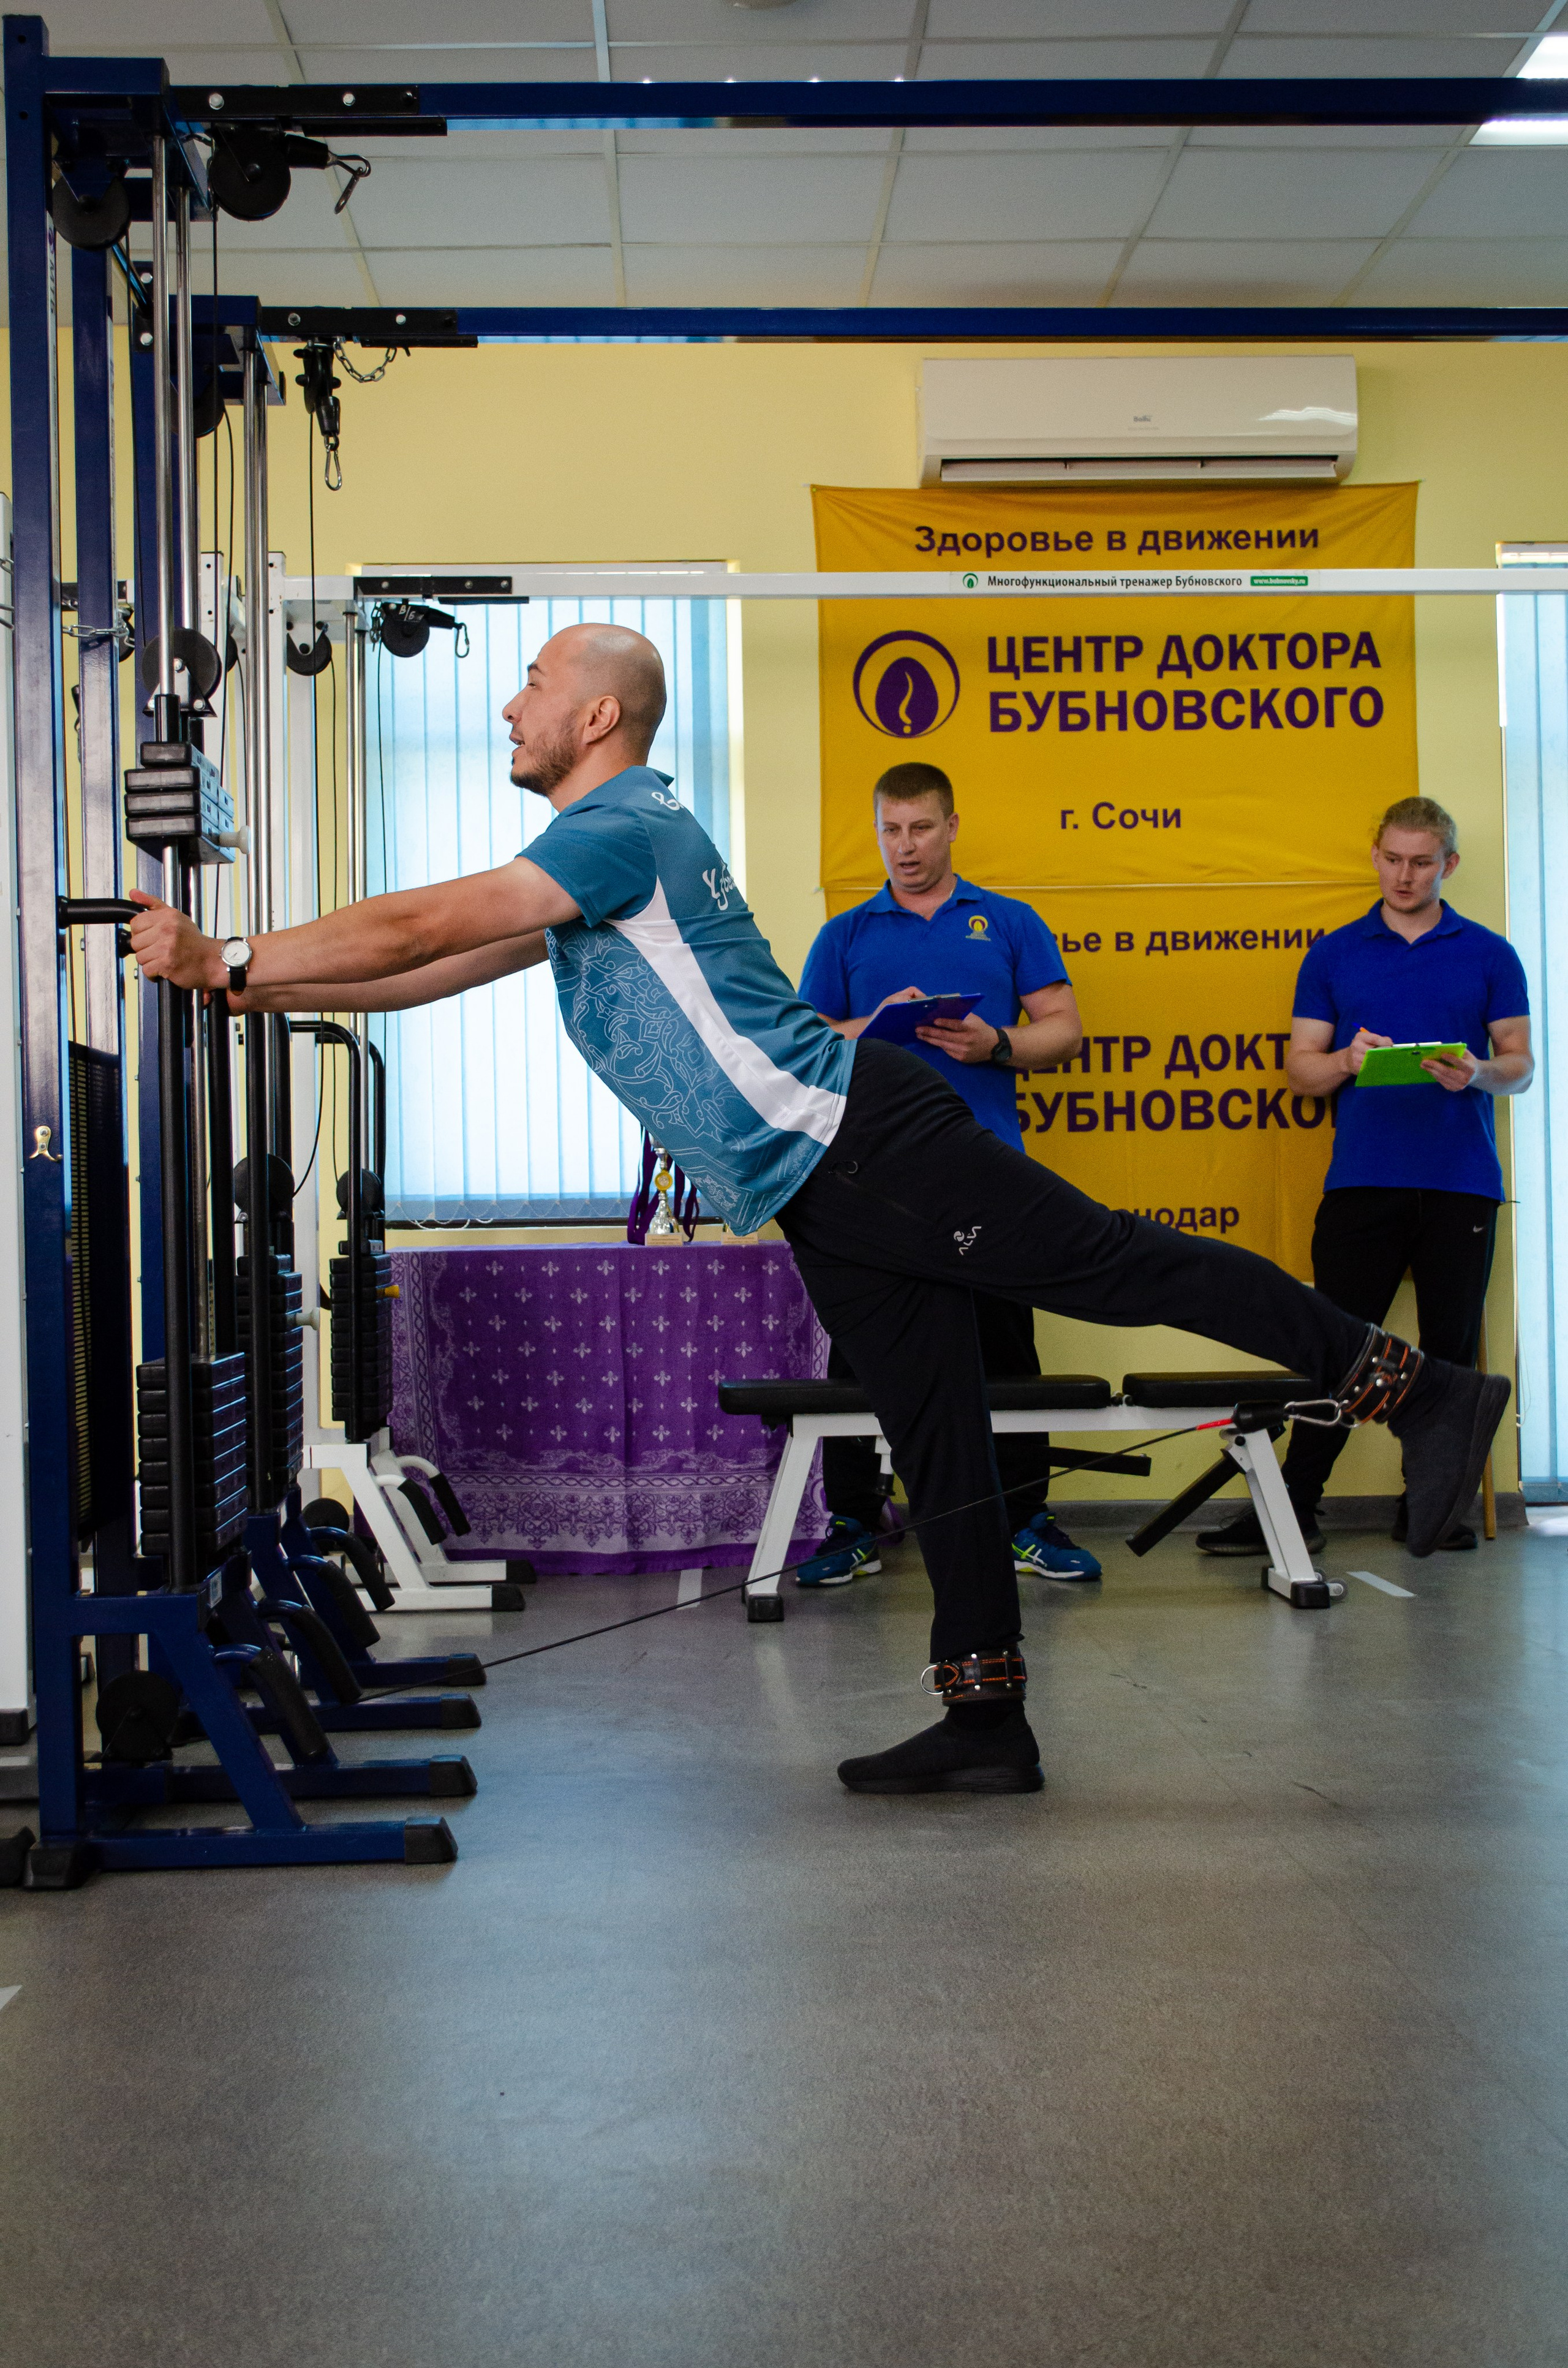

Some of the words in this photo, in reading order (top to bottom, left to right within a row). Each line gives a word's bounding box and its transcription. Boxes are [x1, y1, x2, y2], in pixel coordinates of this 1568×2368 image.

[915, 526, 1093, 558] Здоровье
[1107, 530, 1127, 551] в
[1137, 529, 1319, 556] движении
[987, 576, 1117, 589] Многофункциональный
[1120, 579, 1172, 589] тренажер
[1175, 576, 1242, 589] Бубновского
[988, 635, 1144, 680] ЦЕНТР
[1157, 631, 1382, 678] ДОКТОРА
[990, 686, 1384, 733] БУБНОВСКОГО
[1061, 809, 1079, 830] г.
[1093, 802, 1181, 830] Сочи
[1115, 931, 1134, 951] в
[1145, 928, 1325, 956] движении
